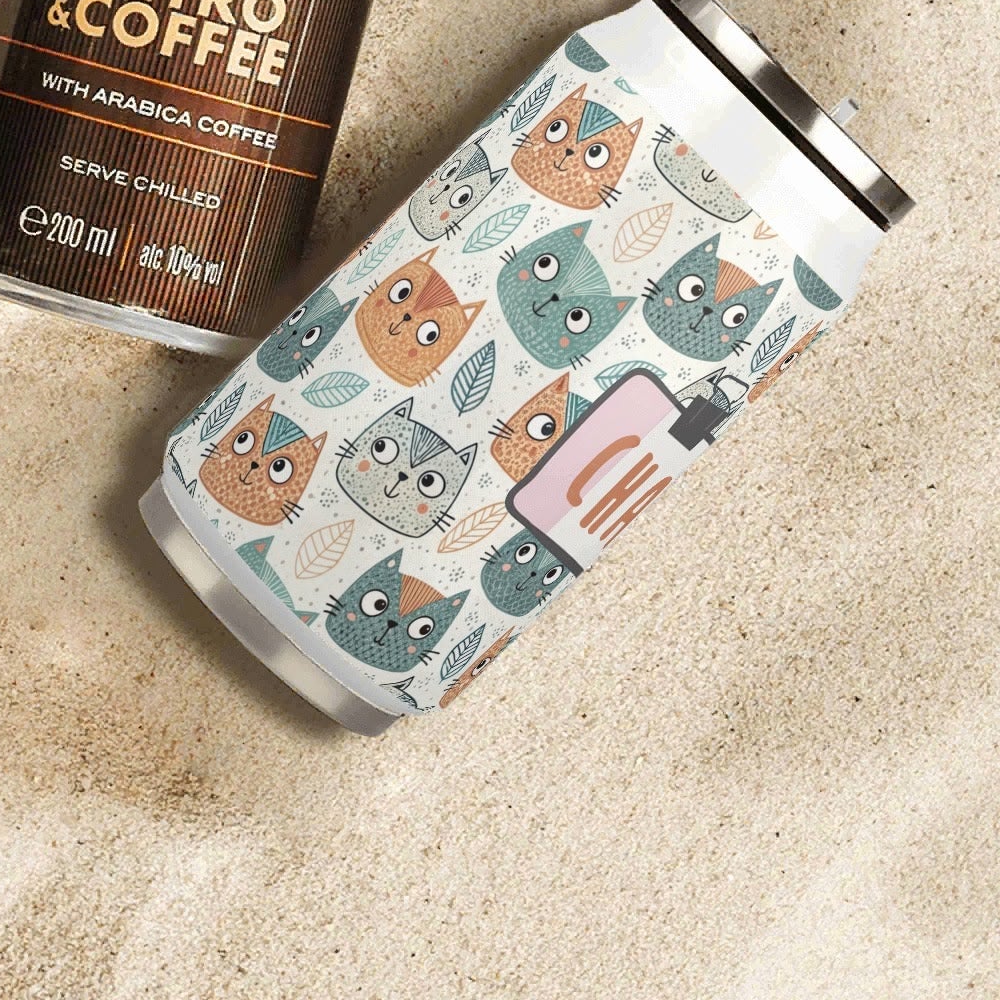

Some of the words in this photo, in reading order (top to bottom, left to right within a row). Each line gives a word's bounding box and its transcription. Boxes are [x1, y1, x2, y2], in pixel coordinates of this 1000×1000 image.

[41, 71, 90, 99] WITH
[92, 87, 193, 128] ARABICA
[197, 115, 278, 150] COFFEE
[59, 155, 129, 187] SERVE
[133, 176, 221, 210] CHILLED
[85, 226, 118, 257] ml
[166, 244, 201, 281] 10%
[203, 260, 225, 287] vol
